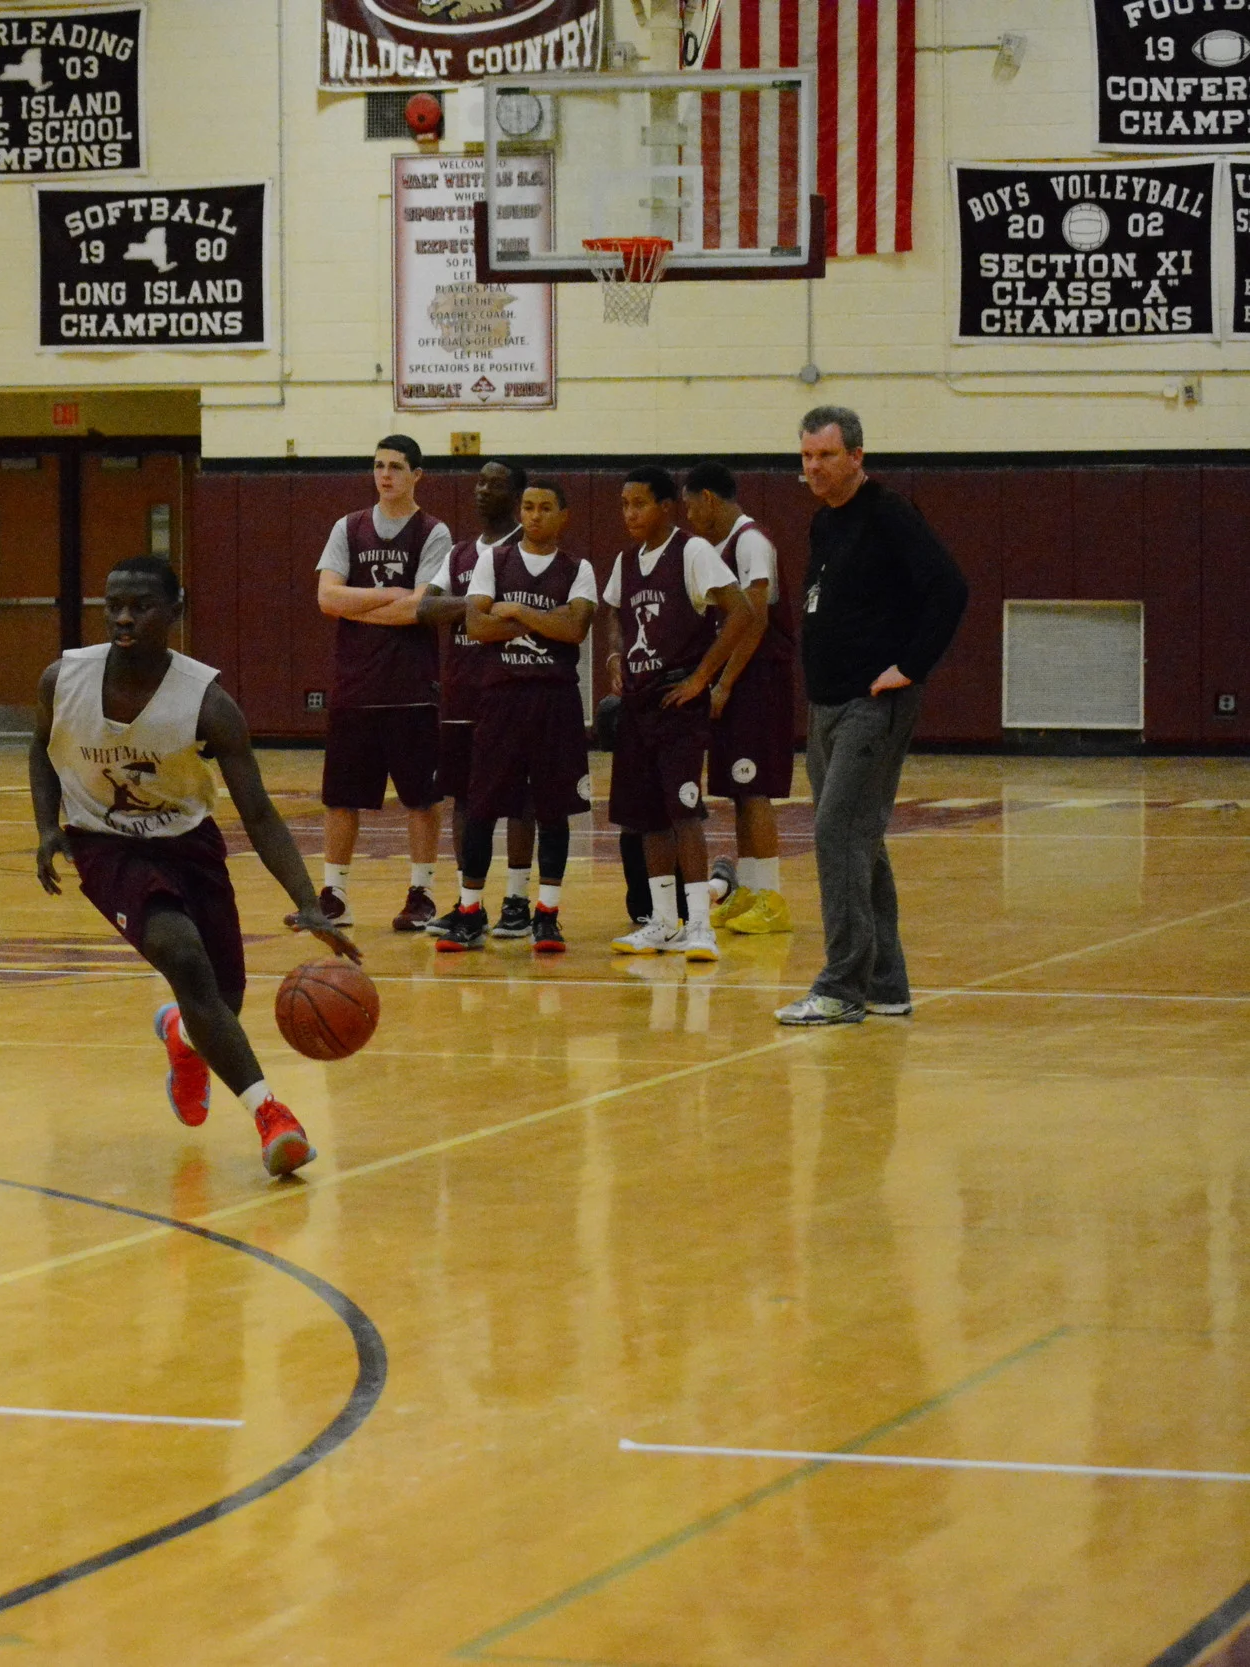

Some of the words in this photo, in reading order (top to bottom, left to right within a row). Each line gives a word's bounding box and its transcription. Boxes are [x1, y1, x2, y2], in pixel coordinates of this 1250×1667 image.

[326, 22, 451, 78] WILDCAT
[468, 9, 597, 74] COUNTRY
[1145, 36, 1174, 61] 19
[58, 57, 98, 80] '03
[1106, 76, 1250, 101] CONFER
[21, 93, 121, 118] ISLAND
[28, 117, 132, 143] SCHOOL
[1120, 110, 1250, 135] CHAMP
[439, 160, 484, 169] WELCOM
[401, 173, 439, 189] WALT
[455, 193, 485, 201] WHER
[967, 182, 1029, 222] BOYS
[1050, 174, 1204, 218] VOLLEYBALL
[64, 198, 237, 238] SOFTBALL
[459, 225, 470, 234] IS
[1008, 214, 1044, 239] 20
[1127, 212, 1164, 237] 02
[79, 240, 104, 264] 19
[196, 238, 227, 261] 80
[446, 259, 459, 267] SO
[979, 253, 1136, 278] SECTION
[1156, 250, 1192, 275] XI
[435, 284, 479, 293] PLAYERS
[454, 272, 471, 281] LET
[59, 282, 126, 306] LONG
[144, 279, 242, 304] ISLAND
[992, 281, 1111, 306] CLASS
[1131, 279, 1179, 304] "A"
[60, 312, 242, 337] CHAMPIONS
[430, 311, 476, 320] COACHES
[981, 306, 1192, 333] CHAMPIONS
[418, 338, 471, 347] OFFICIALS
[454, 351, 470, 360] LET
[475, 351, 493, 359] THE
[409, 364, 469, 373] SPECTATORS
[473, 363, 485, 372] BE
[359, 549, 410, 564] WHITMAN
[501, 653, 554, 665] WILDCATS
[80, 745, 161, 765] WHITMAN
